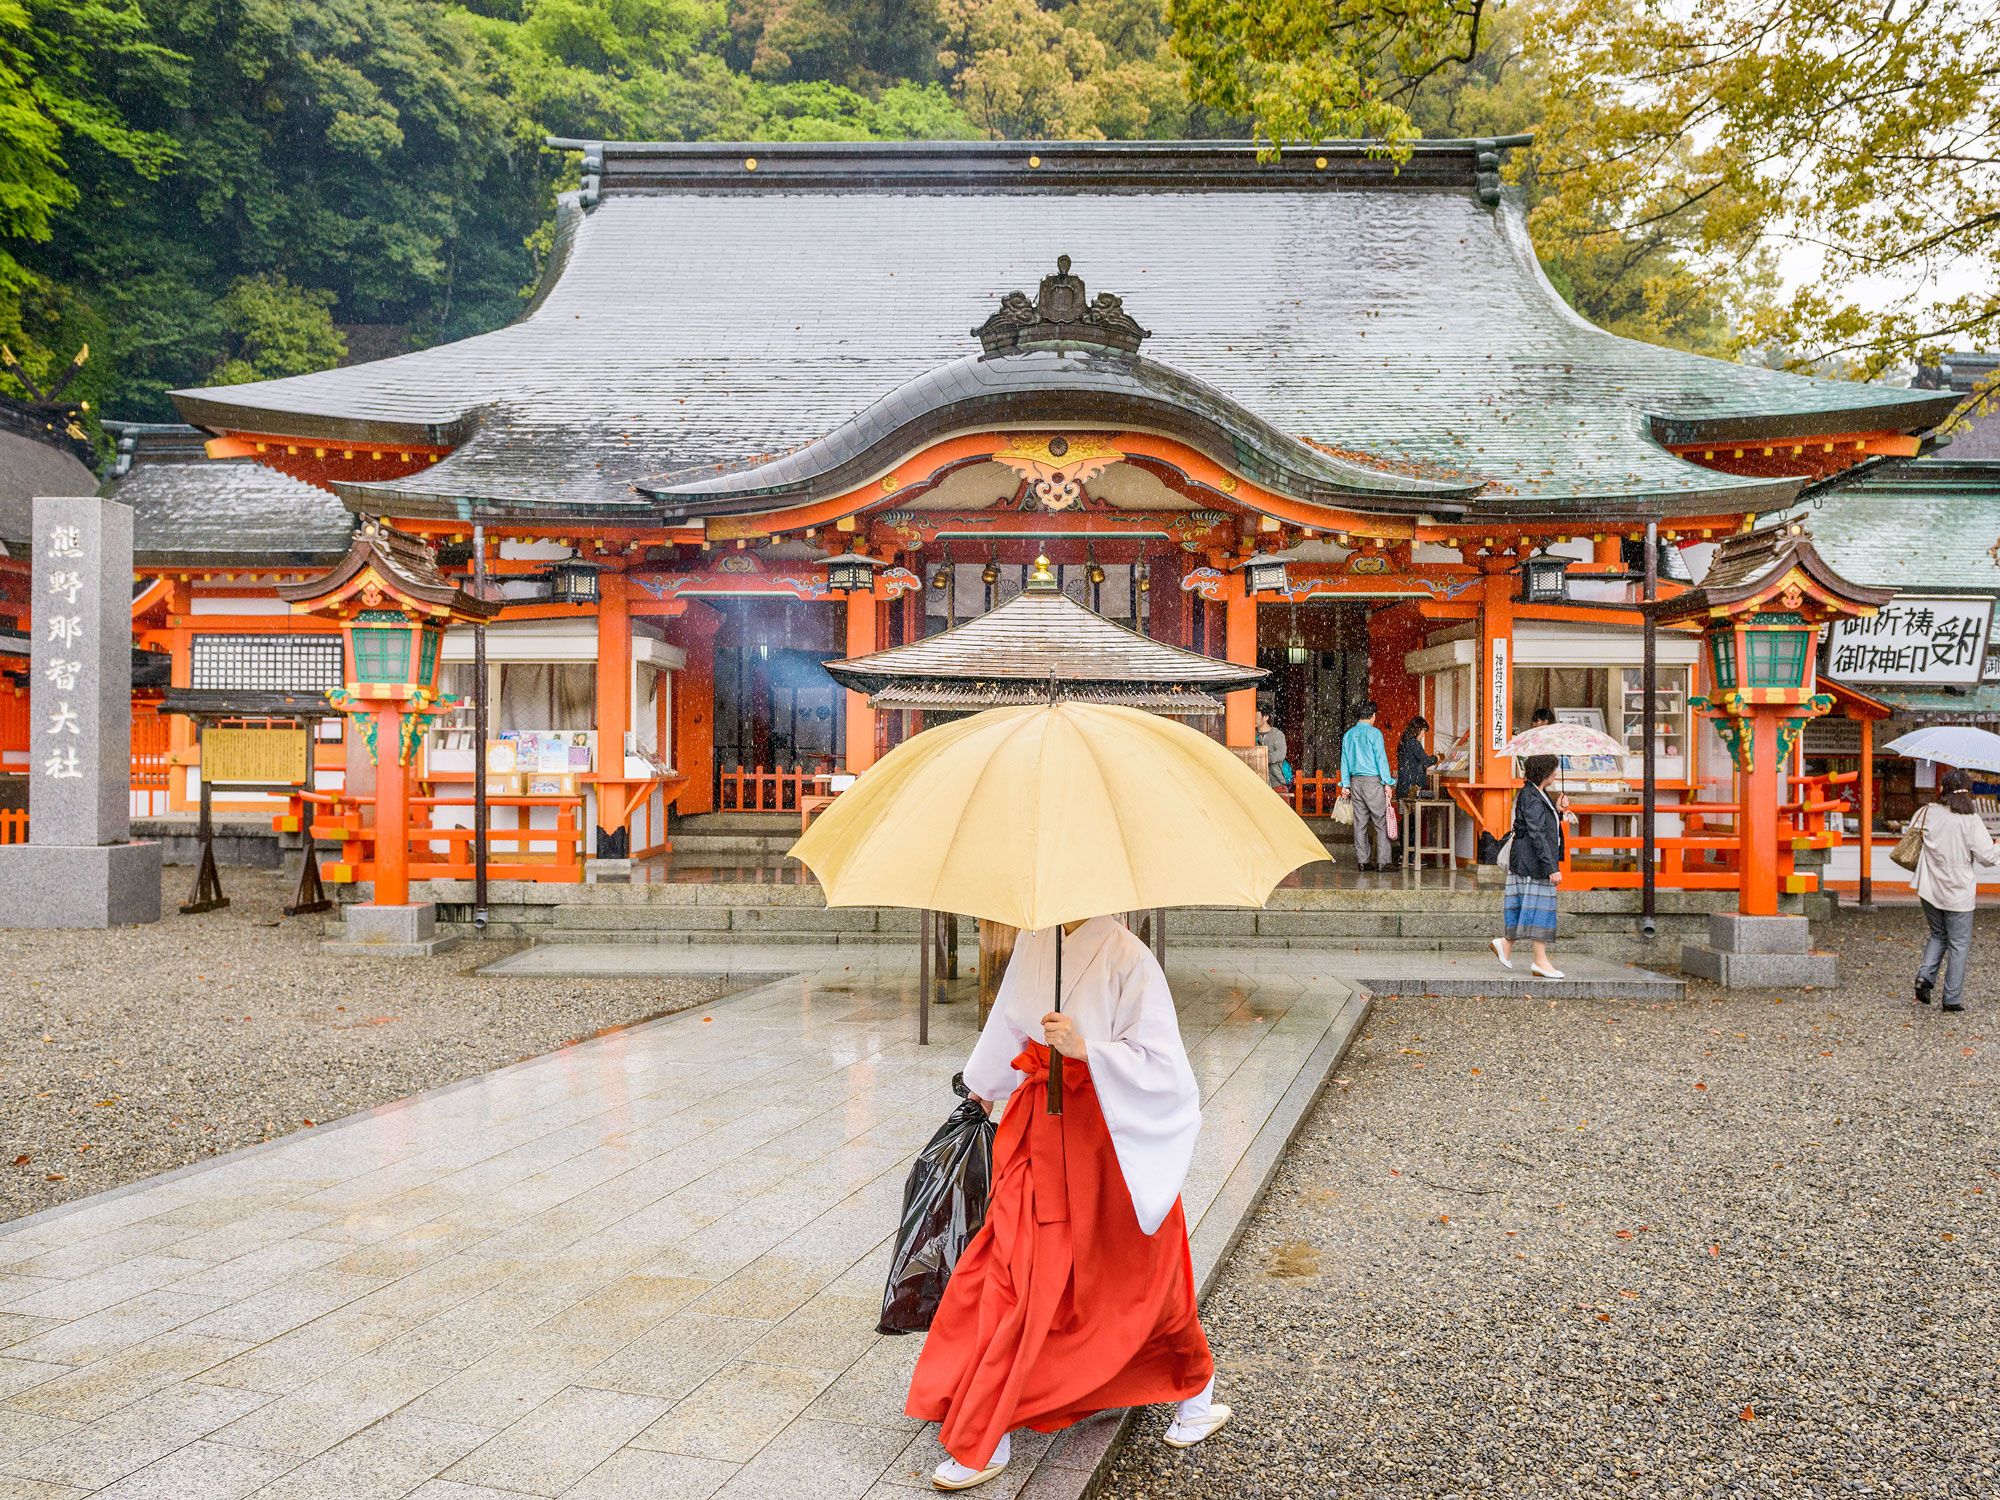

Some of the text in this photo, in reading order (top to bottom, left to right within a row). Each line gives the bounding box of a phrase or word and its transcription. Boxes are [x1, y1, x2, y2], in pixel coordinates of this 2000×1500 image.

[46, 524, 84, 779] 熊野那智大社
[1833, 644, 1929, 674] 御神印
[1929, 615, 1983, 667] 受付
